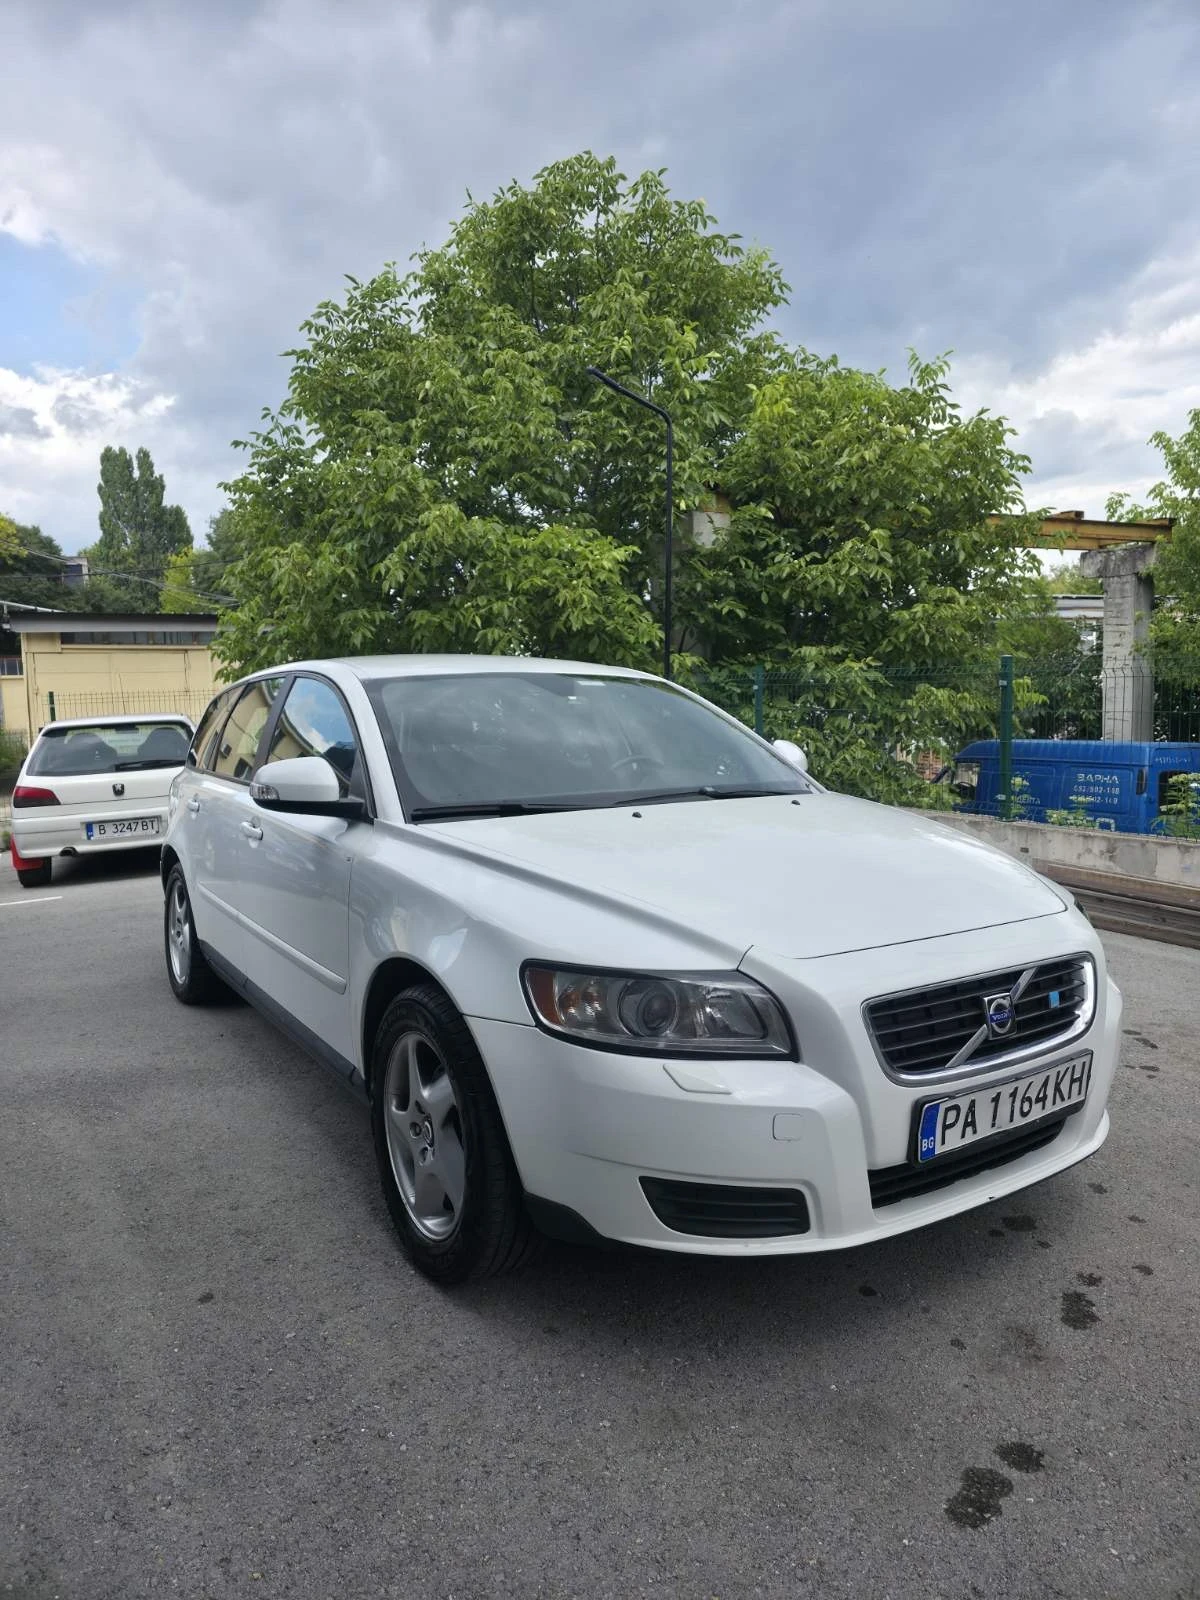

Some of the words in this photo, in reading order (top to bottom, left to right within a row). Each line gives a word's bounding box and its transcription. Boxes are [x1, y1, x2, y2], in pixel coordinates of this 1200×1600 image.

[98, 824, 106, 835] B
[940, 1098, 977, 1146] PA
[922, 1136, 935, 1151] BG
